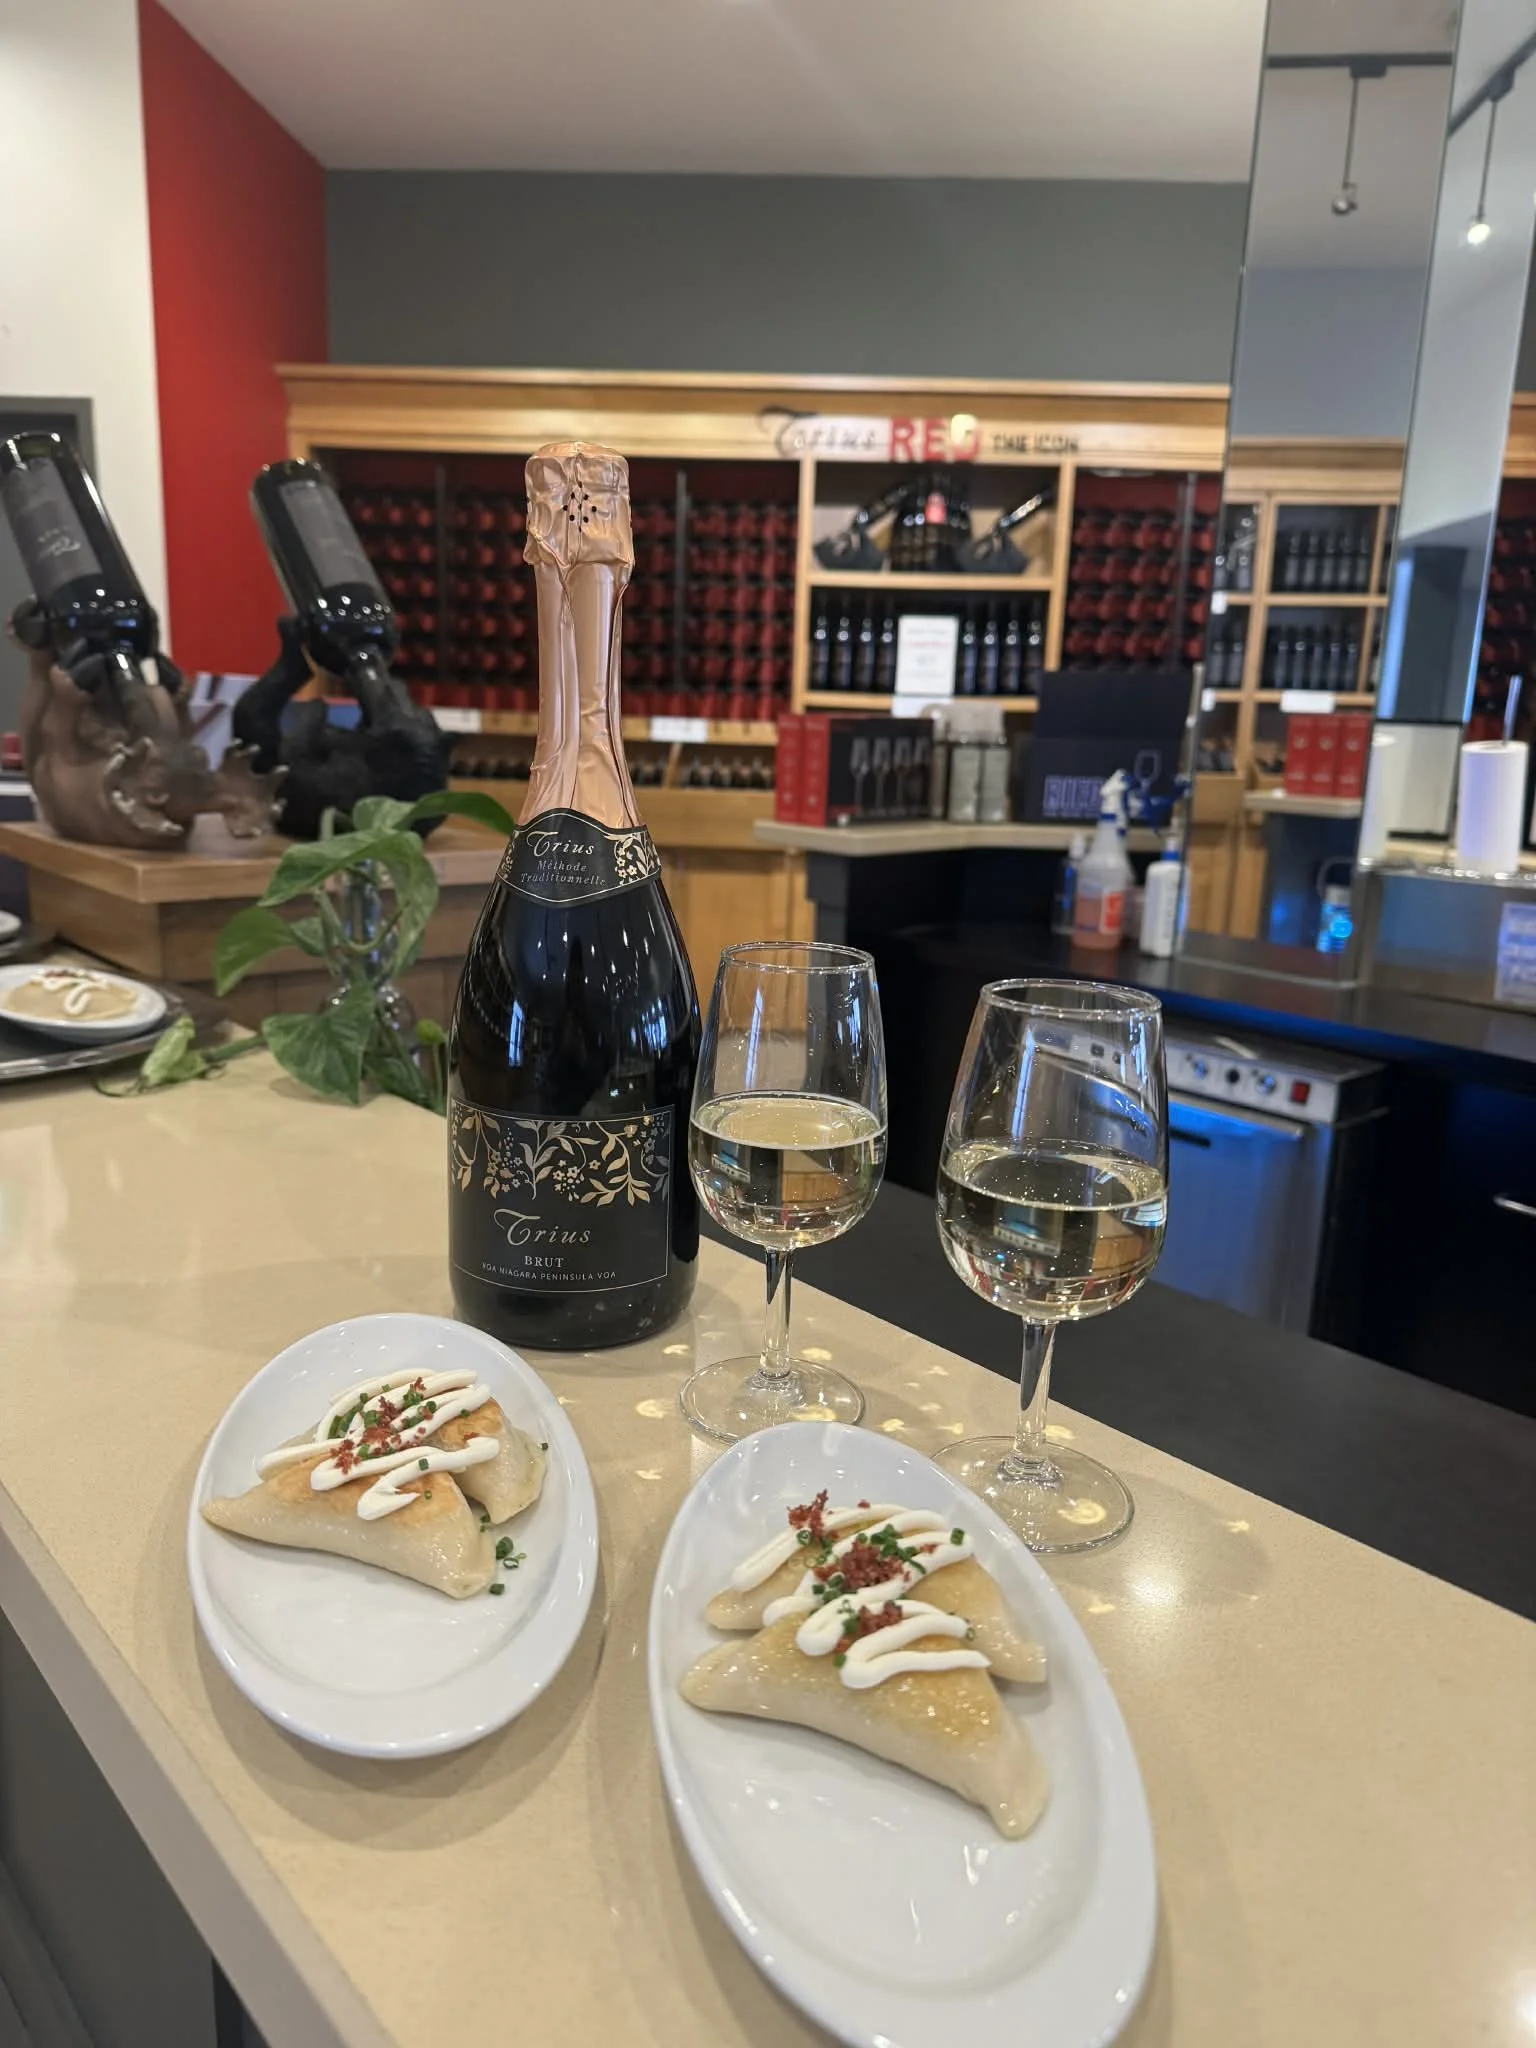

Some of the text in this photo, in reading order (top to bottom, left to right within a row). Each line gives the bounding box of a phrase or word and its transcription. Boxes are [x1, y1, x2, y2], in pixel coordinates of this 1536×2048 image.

[526, 830, 595, 857] Trius
[493, 1208, 591, 1246] Trius
[524, 1255, 564, 1268] BRUT
[499, 1266, 537, 1280] NIAGARA
[540, 1272, 594, 1281] PENINSULA
